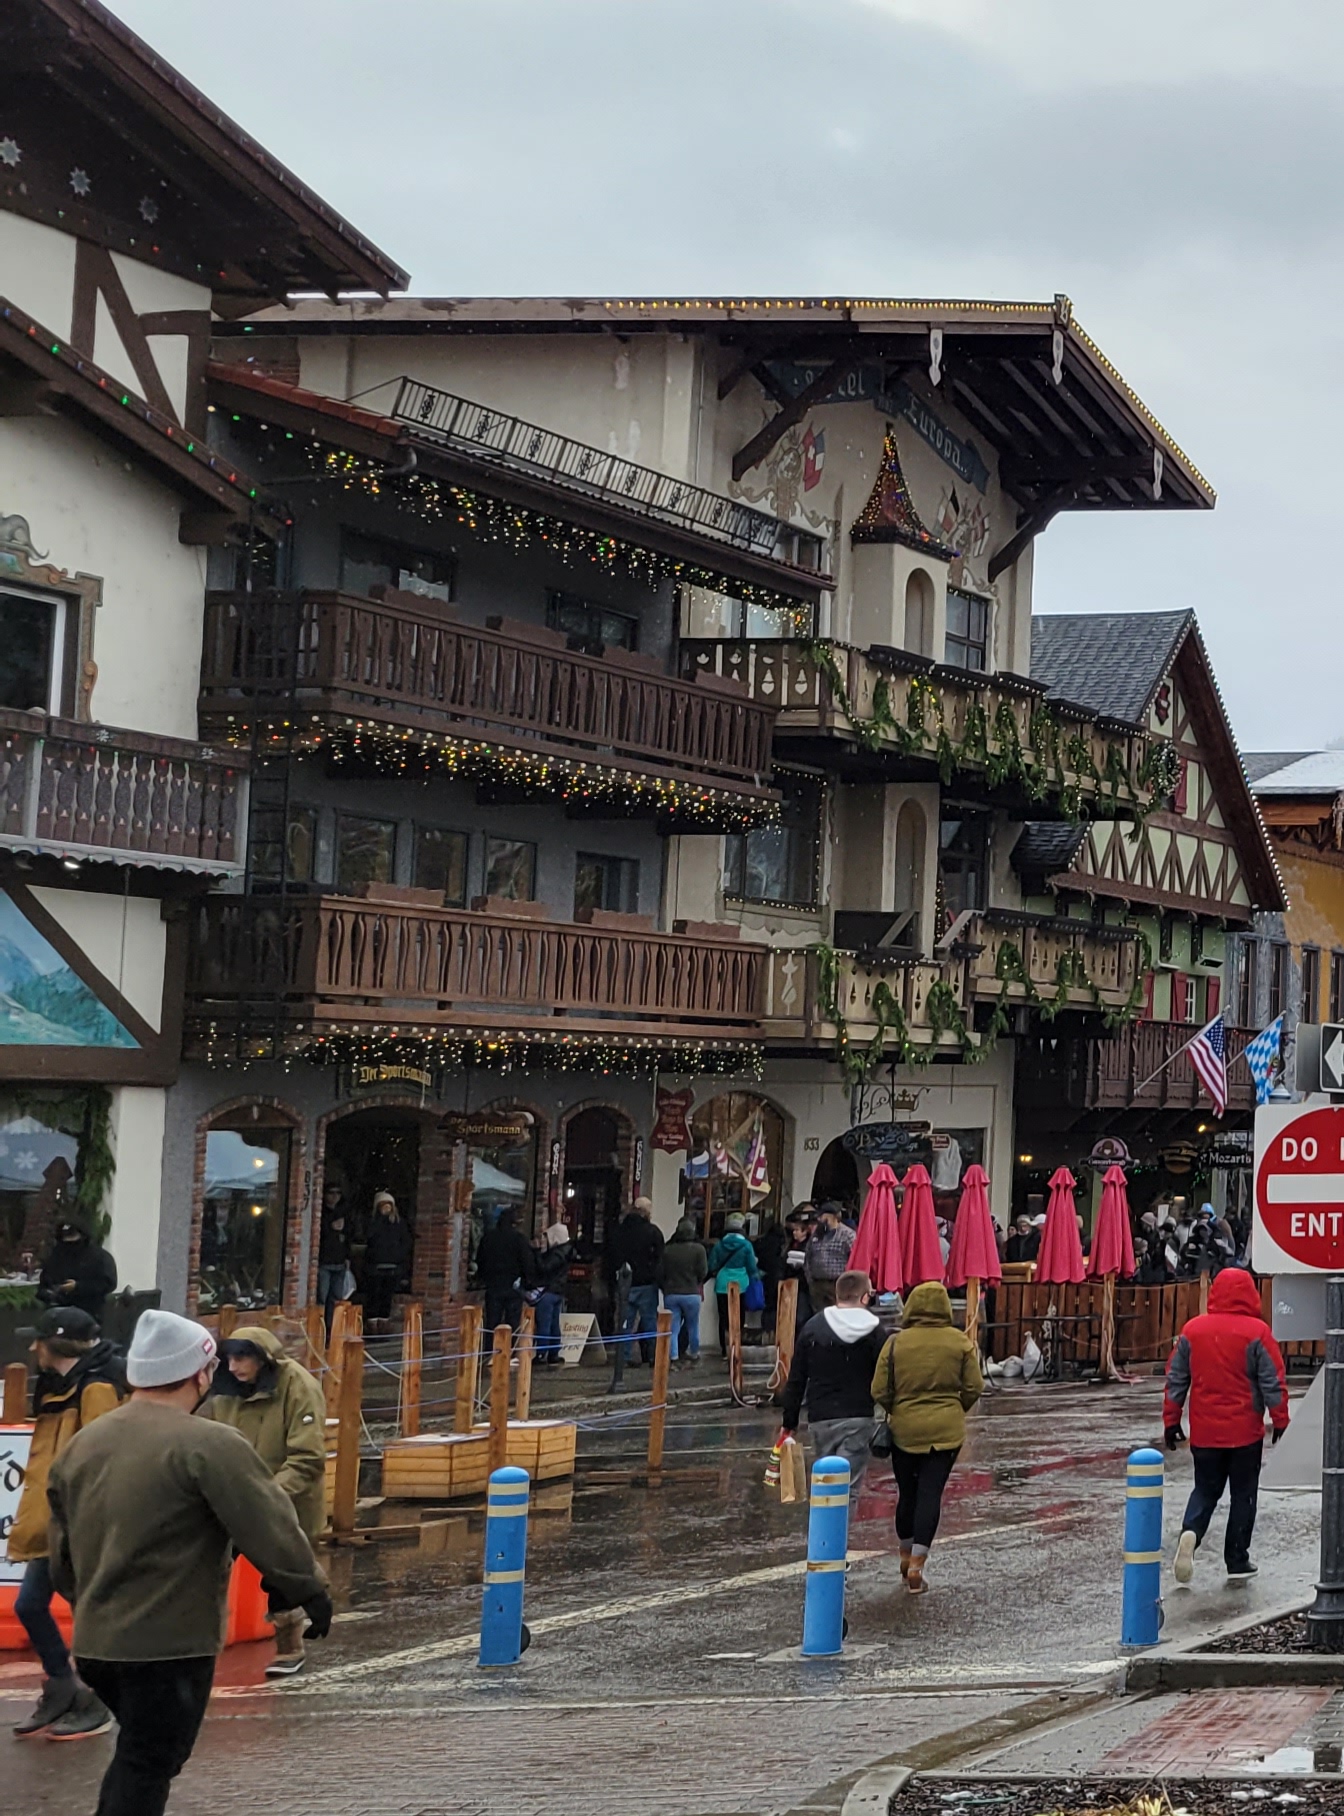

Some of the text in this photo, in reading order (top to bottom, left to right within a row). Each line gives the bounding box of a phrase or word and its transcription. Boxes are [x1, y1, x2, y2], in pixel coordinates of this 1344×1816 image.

[359, 1065, 377, 1084] Der
[457, 1122, 522, 1136] Sportsmann
[1280, 1136, 1318, 1163] DO
